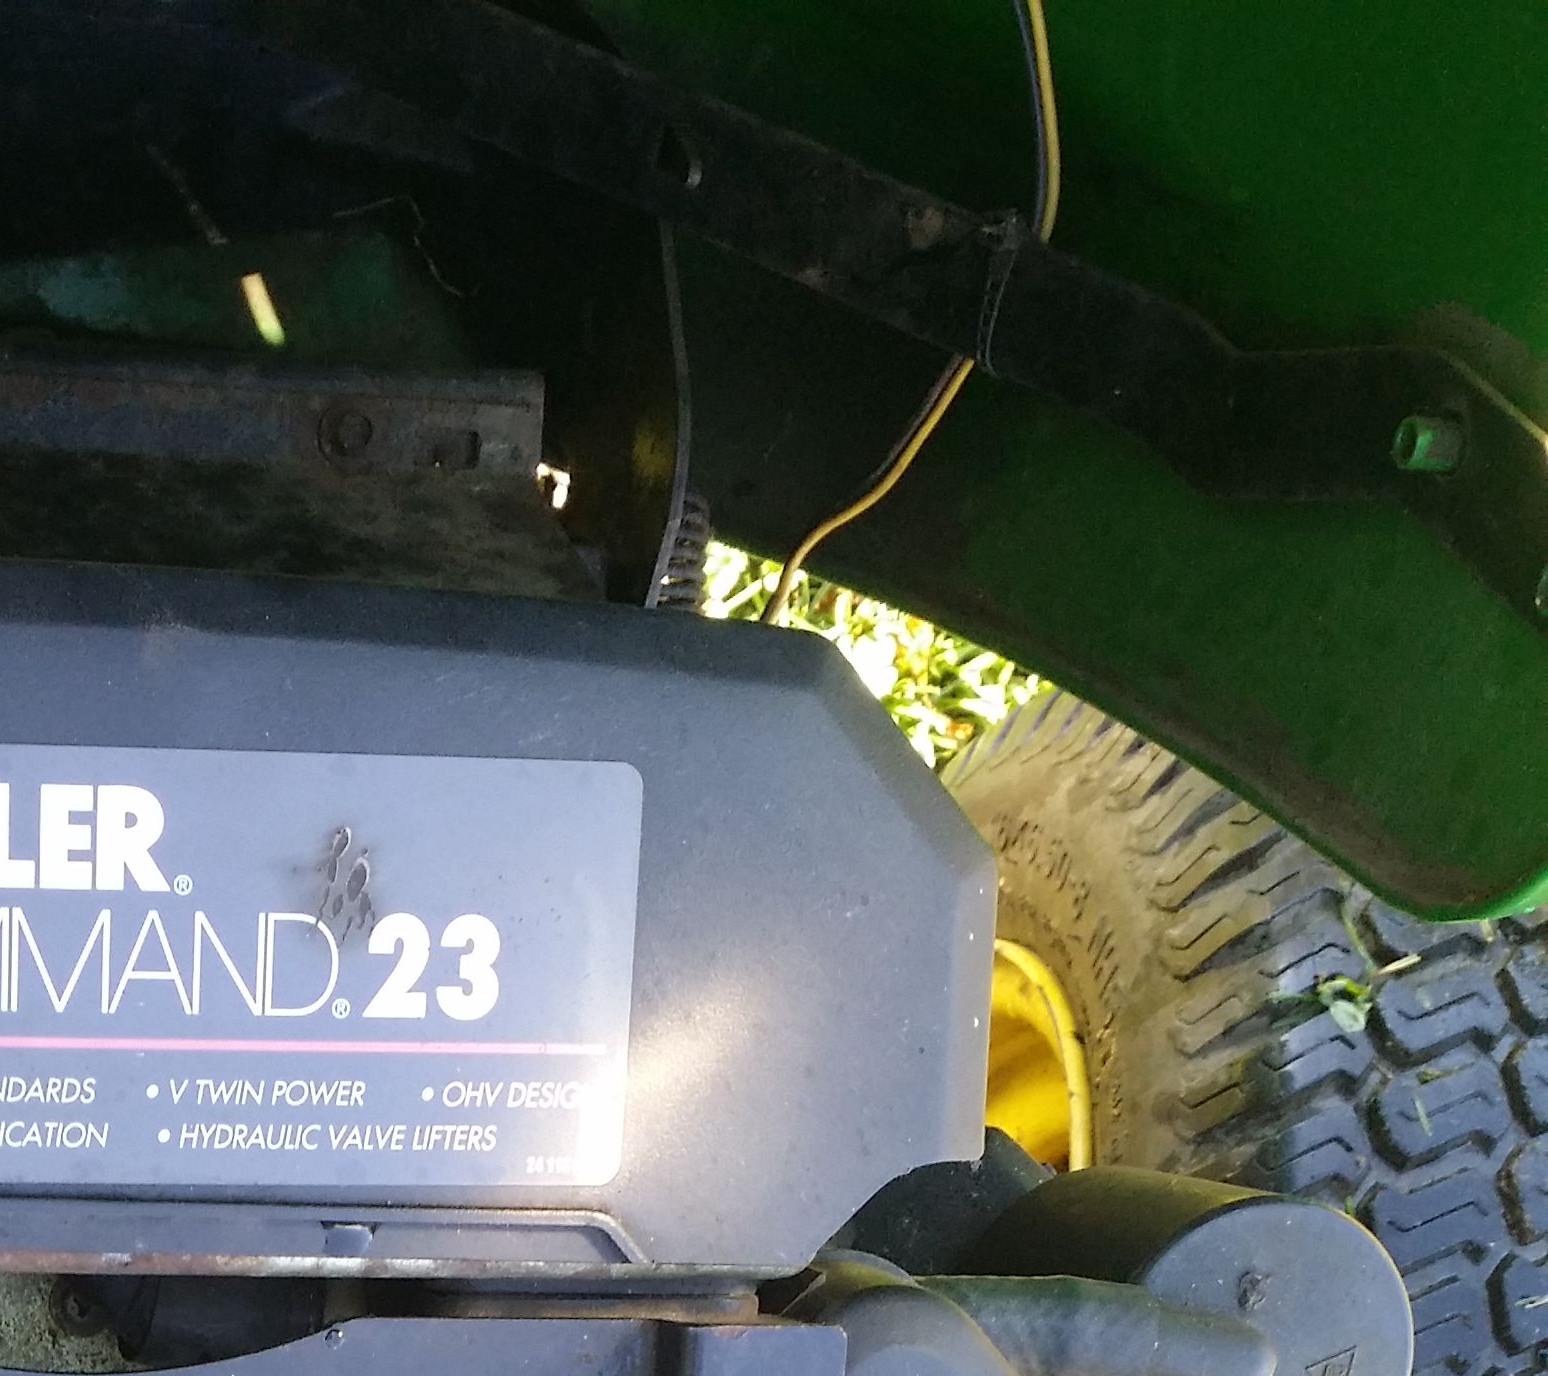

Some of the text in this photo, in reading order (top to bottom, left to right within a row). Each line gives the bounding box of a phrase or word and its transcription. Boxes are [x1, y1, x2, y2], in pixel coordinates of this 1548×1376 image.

[362, 912, 501, 1021] 23
[168, 1079, 366, 1107] V TWIN POWER
[441, 1081, 584, 1109] OHV DESIG
[178, 1123, 498, 1153] HYDRAULIC VALVE LIFTERS
